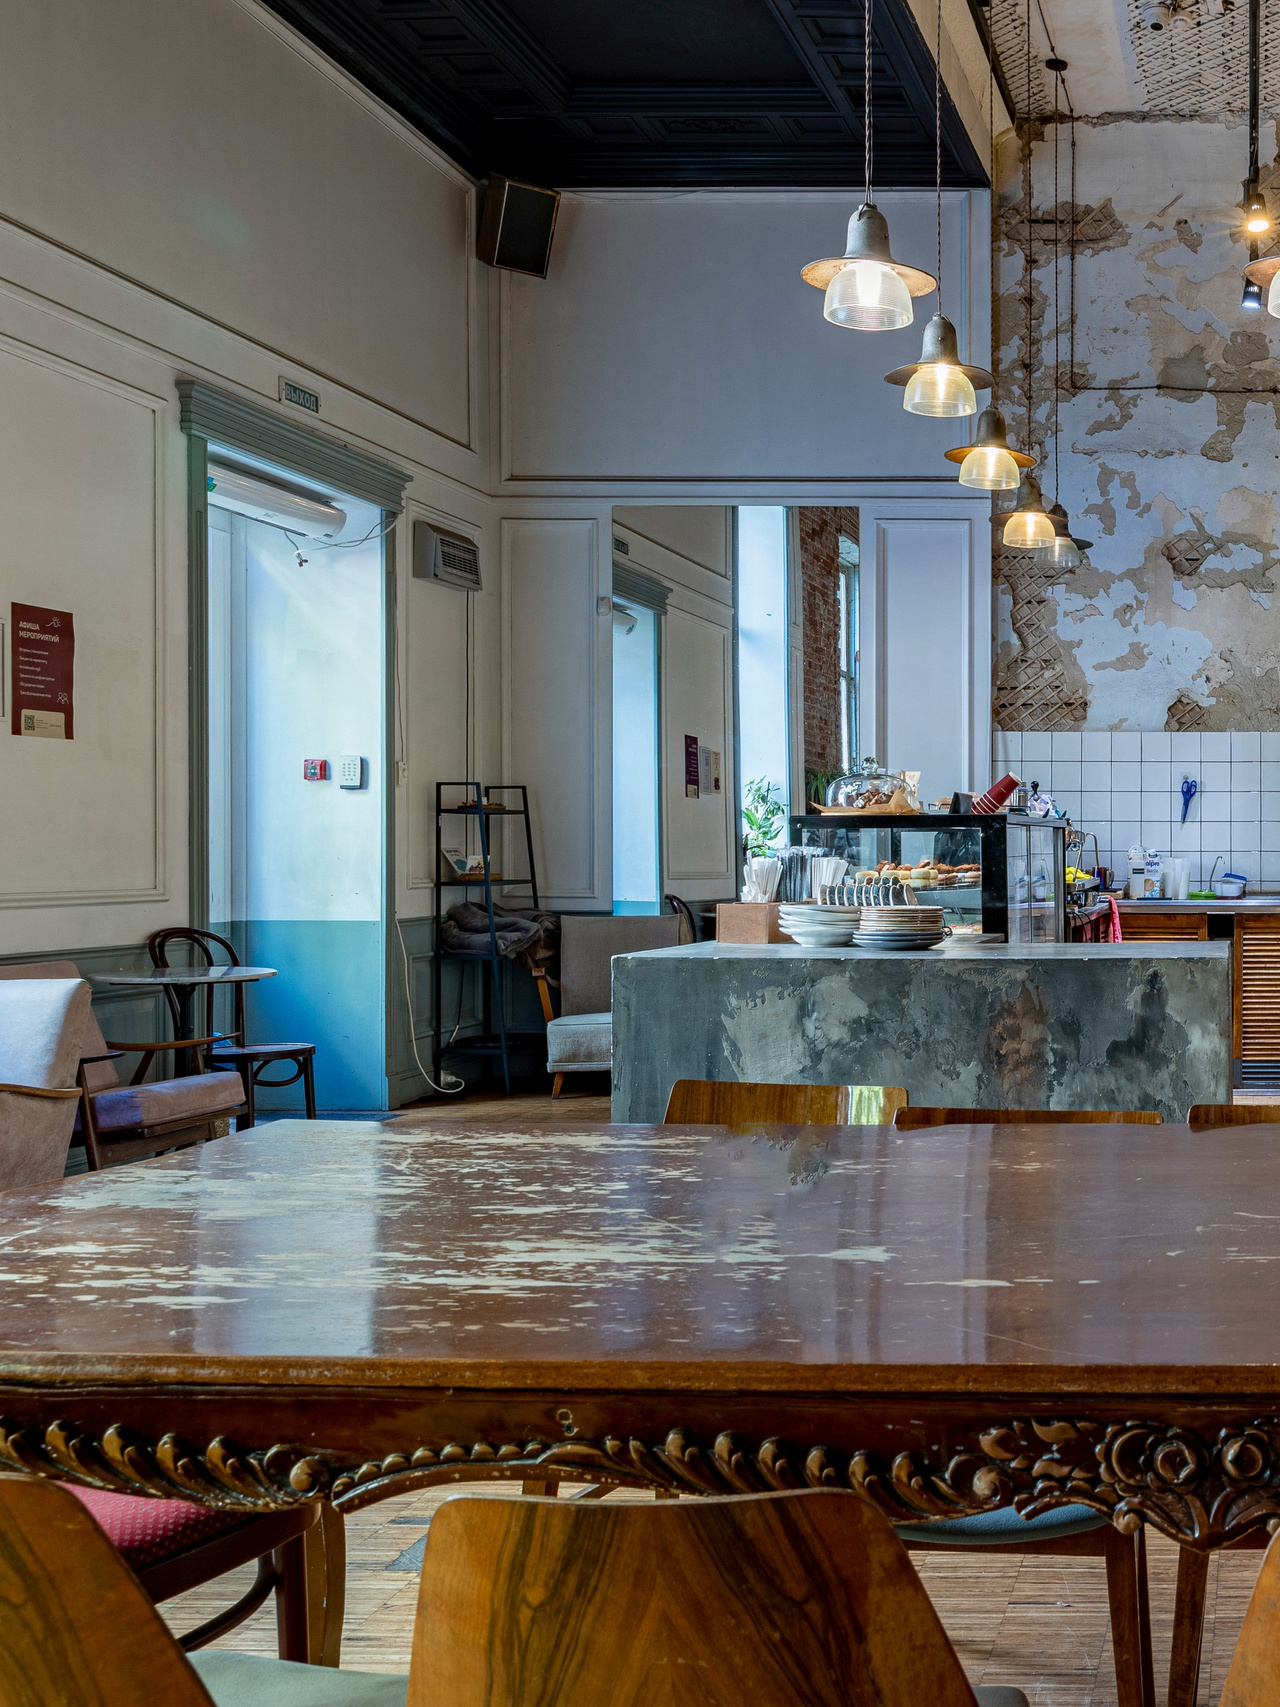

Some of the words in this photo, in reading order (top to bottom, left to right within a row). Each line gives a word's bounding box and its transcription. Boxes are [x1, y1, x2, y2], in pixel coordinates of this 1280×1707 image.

[285, 385, 317, 411] ВЫХОД
[19, 621, 40, 630] АФИША
[19, 630, 60, 643] МЕРОПРИЯТИЙ
